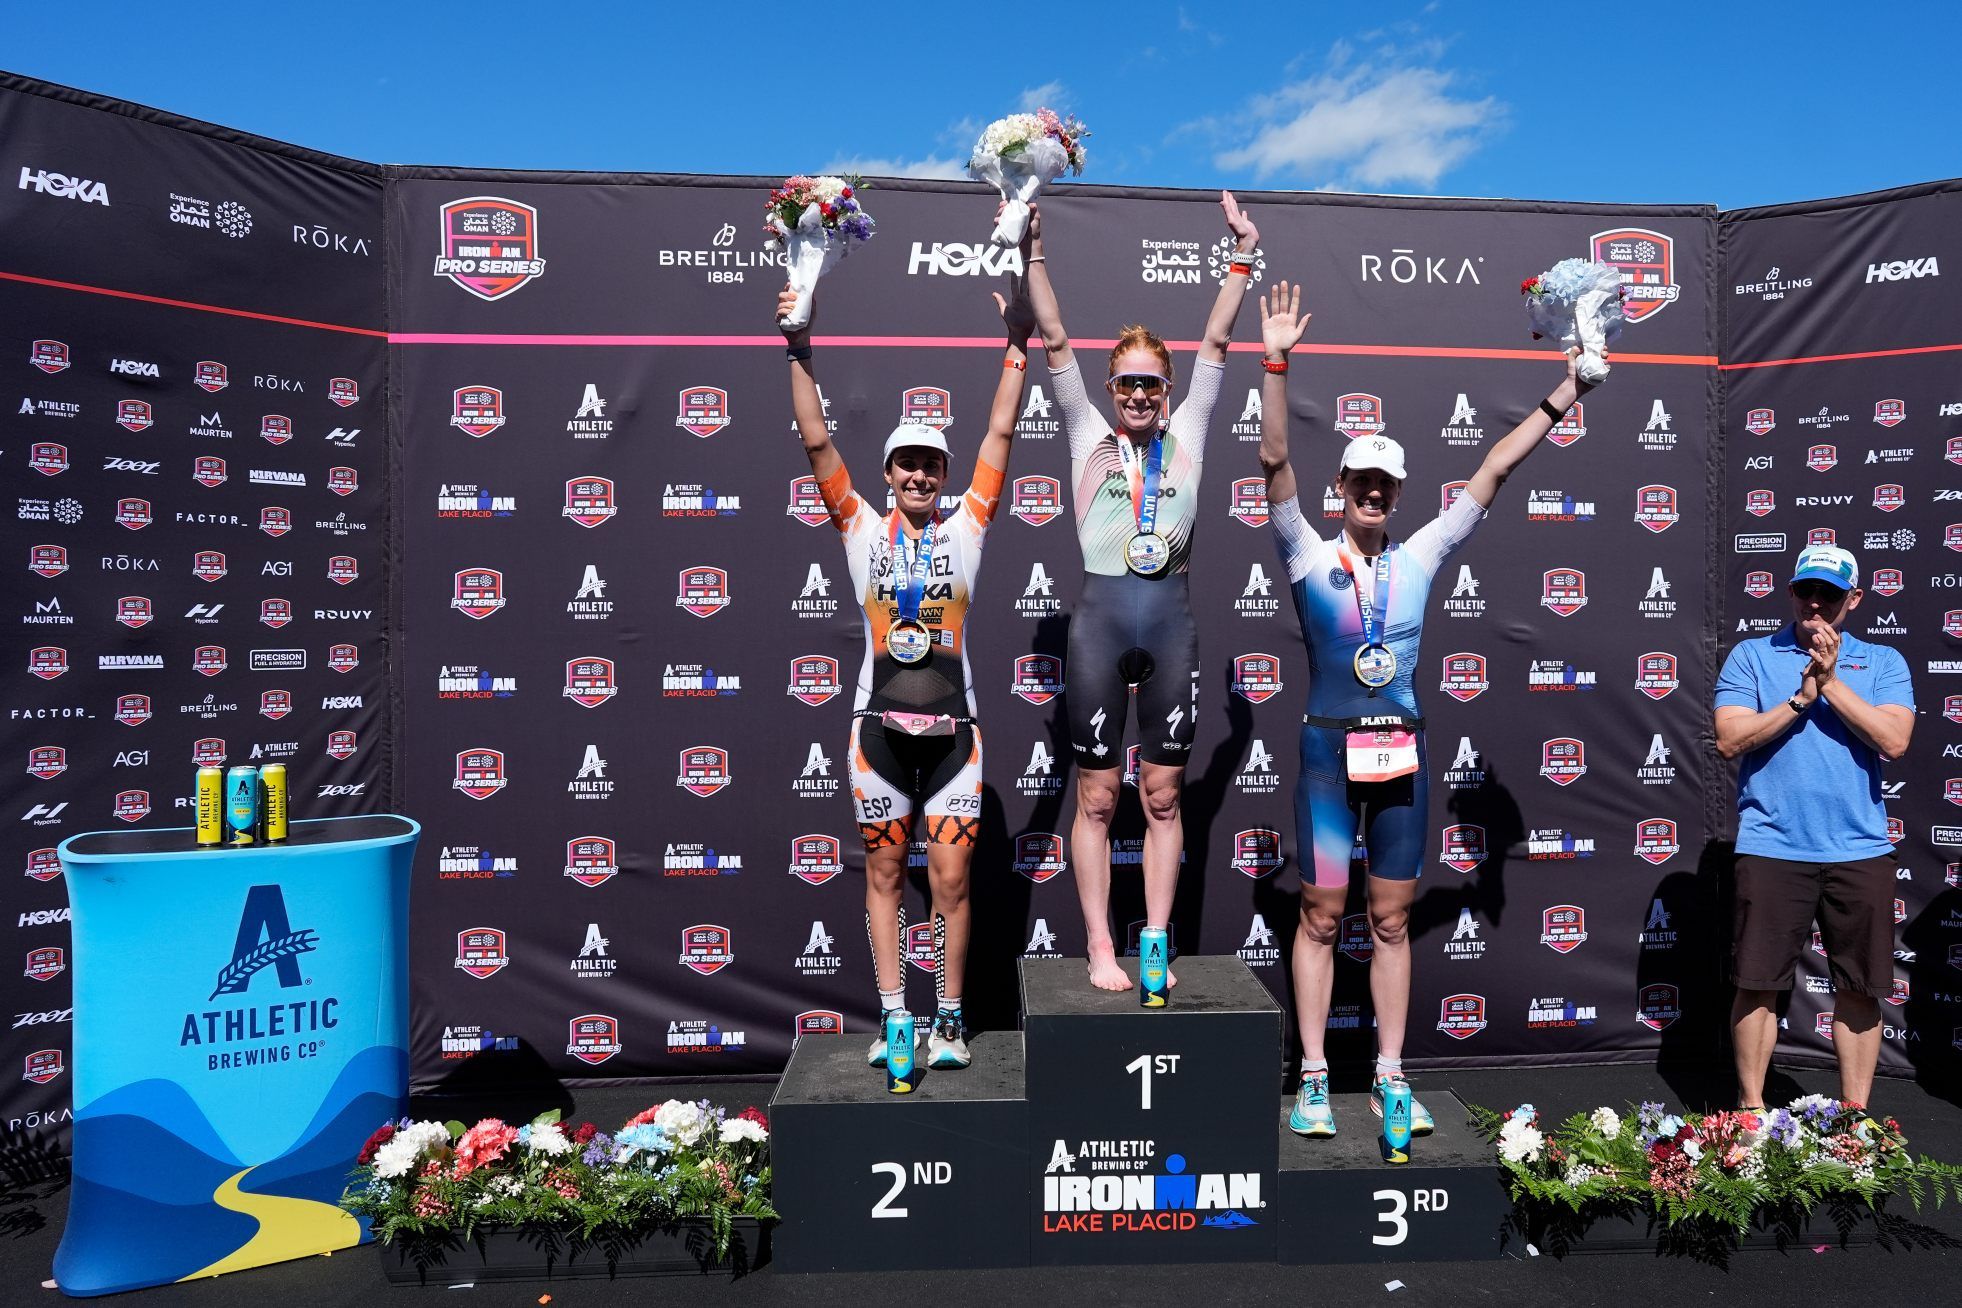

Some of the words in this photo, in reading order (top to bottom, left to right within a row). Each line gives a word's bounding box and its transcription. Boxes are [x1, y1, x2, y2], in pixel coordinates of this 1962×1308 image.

[19, 167, 109, 206] HOKA
[170, 192, 209, 206] Experience
[170, 213, 209, 229] OMAN
[459, 243, 521, 258] IRONMAN
[1142, 240, 1200, 251] Experience
[660, 250, 788, 267] BREITLING
[908, 241, 1024, 277] HOKA
[1610, 253, 1632, 261] OMAN
[438, 259, 477, 273] PRO
[479, 260, 542, 275] SERIES
[1865, 256, 1940, 284] HOKA
[708, 271, 744, 283] 1884
[1142, 269, 1200, 284] OMAN
[1735, 278, 1813, 295] BREITLING
[1632, 286, 1678, 300] ERIES
[1763, 292, 1784, 301] 1884
[110, 359, 160, 378] HOKA
[38, 400, 80, 413] ATHLETIC
[452, 417, 469, 425] PRO
[470, 417, 504, 425] SERIES
[677, 417, 694, 425] PRO
[695, 417, 730, 425] SERIES
[1798, 414, 1850, 424] BREITLING
[567, 420, 613, 431] ATHLETIC
[1014, 421, 1059, 432] ATHLETIC
[190, 428, 232, 438] MAURTEN
[1441, 428, 1483, 438] ATHLETIC
[1879, 448, 1914, 458] ATHLETIC
[1744, 456, 1773, 470] AG1
[450, 484, 477, 492] ATHLETIC
[675, 484, 702, 492] ATHLETIC
[438, 494, 516, 510] IRONMAN
[663, 493, 741, 510] IRONMAN
[1796, 496, 1853, 506] ROUVY
[564, 507, 581, 515] PRO
[581, 507, 616, 515] SERIES
[1012, 505, 1029, 514] PRO
[1030, 505, 1063, 514] SERIES
[1144, 495, 1156, 519] JULY
[1529, 499, 1596, 515] IRONMAN
[18, 512, 49, 521] OMAN
[1636, 514, 1650, 522] PRO
[1651, 514, 1678, 522] SERIES
[316, 521, 366, 530] BREITLING
[1738, 536, 1782, 545] PRECISION
[1864, 542, 1889, 550] OMAN
[262, 562, 293, 576] AG1
[878, 555, 953, 577] SAEZ
[893, 545, 907, 590] FINISHER
[914, 557, 929, 579] JULY
[878, 583, 954, 601] HKA
[792, 600, 838, 611] ATHLETIC
[1015, 599, 1060, 610] ATHLETIC
[1444, 600, 1486, 610] ATHLETIC
[1542, 597, 1558, 605] PRO
[1559, 597, 1587, 605] SERIES
[567, 602, 613, 612] ATHLETIC
[889, 607, 944, 617] CWN
[24, 616, 73, 624] MAURTEN
[314, 610, 372, 620] ROUVY
[1750, 619, 1782, 627] ATHLETIC
[1867, 627, 1907, 635] MAURTEN
[254, 653, 302, 662] PRECISION
[439, 674, 517, 691] IRONMAN
[1441, 682, 1458, 690] PRO
[1458, 682, 1488, 690] SERIES
[565, 687, 583, 696] PRO
[584, 687, 616, 696] SERIES
[181, 703, 237, 712] BREITLING
[322, 696, 363, 709] HOKA
[1361, 716, 1402, 726] PLAYTRI
[265, 742, 299, 752] ATHLETIC
[113, 751, 148, 767] AG1
[1377, 753, 1390, 767] F9
[1637, 767, 1675, 777] ATHLETIC
[679, 777, 696, 785] PRO
[697, 776, 729, 785] SERIES
[792, 779, 839, 790] ATHLETIC
[1235, 775, 1280, 786] ATHLETIC
[201, 787, 210, 829] ATHLETIC
[267, 784, 276, 826] ATHLETIC
[862, 797, 892, 819] ESP
[664, 852, 743, 869] IRONMAN
[456, 959, 474, 967] PRO
[475, 958, 508, 967] SERIES
[570, 959, 617, 970] ATHLETIC
[795, 957, 841, 968] ATHLETIC
[1528, 1005, 1597, 1022] IRONMAN
[181, 997, 338, 1047] ATHLETIC
[1549, 1020, 1576, 1028] PLACID
[208, 1045, 290, 1070] BREWING
[1079, 1140, 1155, 1158] ATHLETIC
[1092, 1161, 1129, 1170] BREWING
[871, 1161, 952, 1219] 2ND
[1044, 1165, 1264, 1212] IRONMAN
[1043, 1214, 1103, 1232] LAKE
[1111, 1212, 1196, 1232] PLACID
[1372, 1189, 1449, 1246] 3RD
